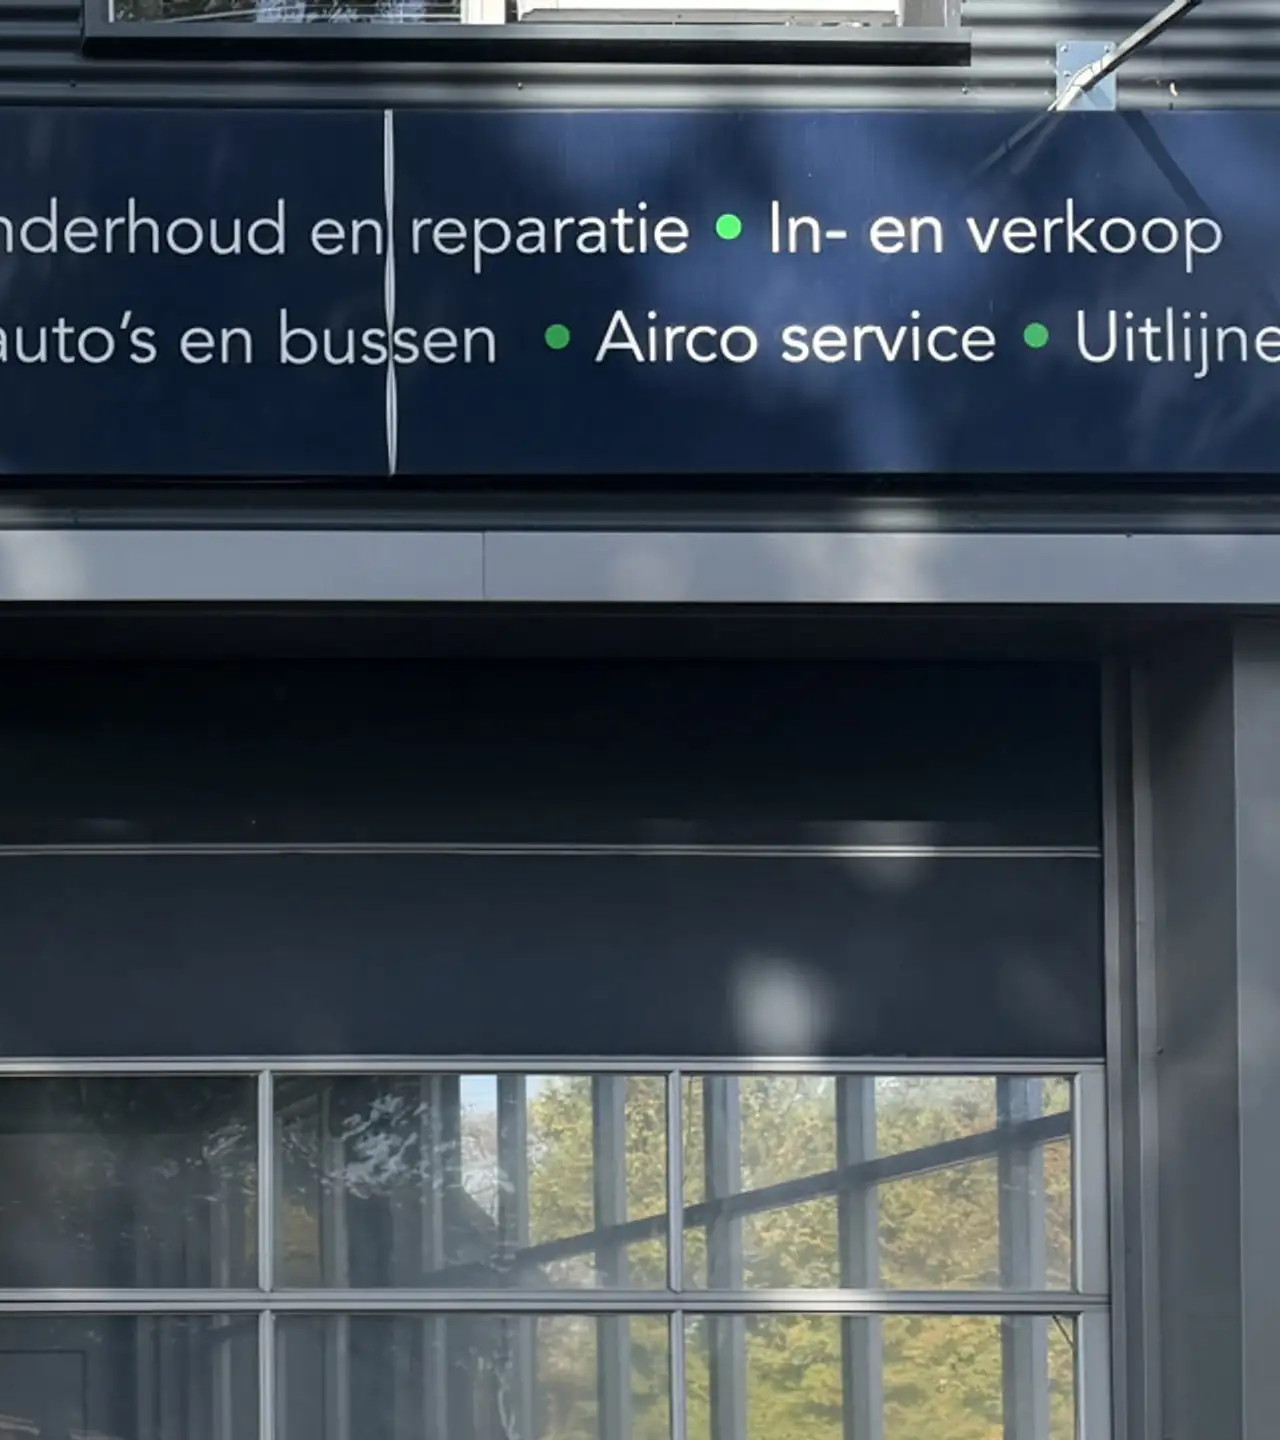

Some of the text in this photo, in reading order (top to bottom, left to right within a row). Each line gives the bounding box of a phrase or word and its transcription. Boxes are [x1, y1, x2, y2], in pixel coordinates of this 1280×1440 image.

[310, 217, 383, 255] en
[411, 201, 690, 274] reparatie
[771, 200, 848, 254] In-
[869, 216, 944, 255] en
[965, 197, 1224, 274] verkoop
[180, 326, 252, 364] en
[279, 308, 496, 364] bussen
[595, 309, 759, 363] Airco
[781, 309, 996, 364] service
[1076, 306, 1280, 379] Uitlijne
